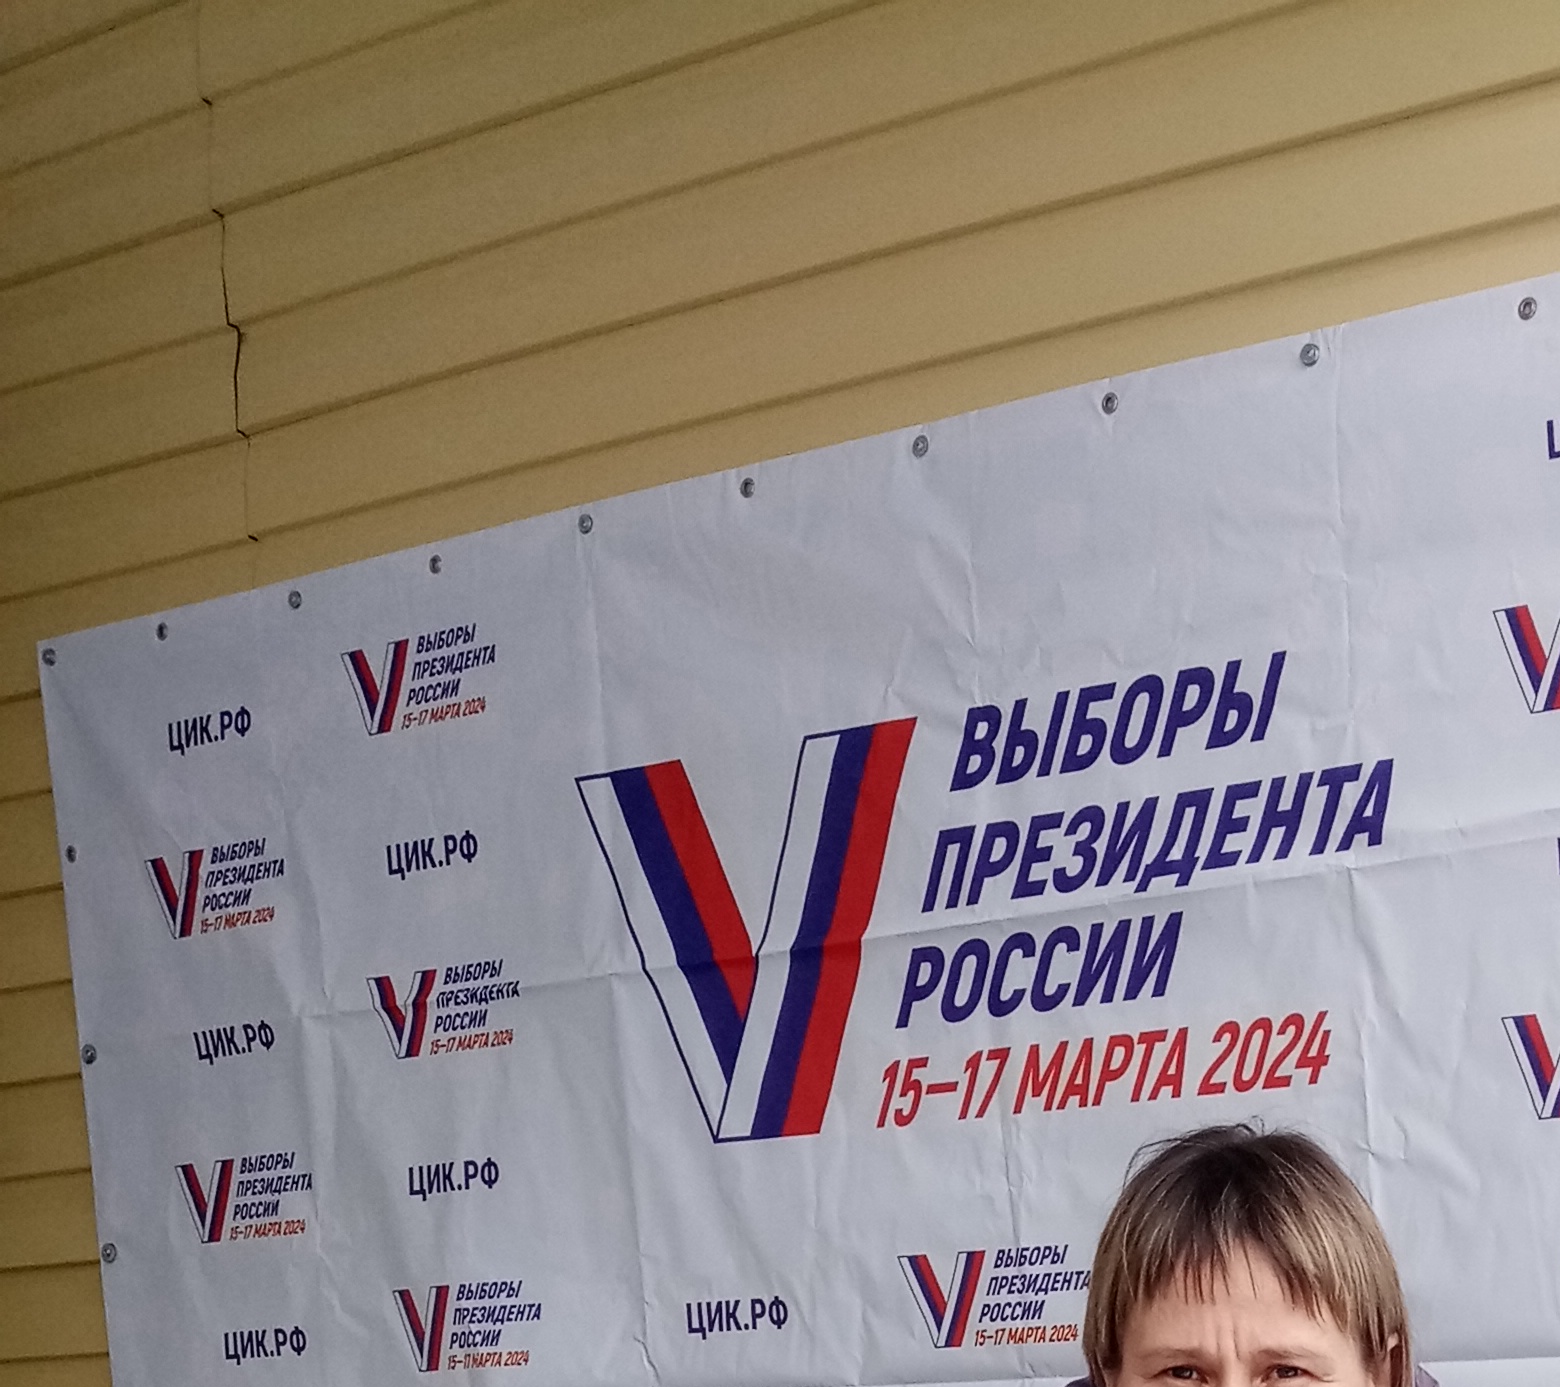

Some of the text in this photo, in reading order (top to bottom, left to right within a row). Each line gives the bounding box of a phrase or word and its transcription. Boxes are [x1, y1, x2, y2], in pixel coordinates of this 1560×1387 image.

[416, 623, 476, 654] ВЫБОРЫ
[412, 644, 495, 681] ПРЕЗИДЕНТА
[406, 678, 461, 707] РОССИИ
[429, 702, 461, 724] МАРТА
[463, 697, 485, 716] 2024
[950, 651, 1286, 792] ВЫБОРЫ
[168, 706, 251, 756] ЦИК.РФ
[921, 758, 1394, 912] ПРЕЗИДЕНТА
[211, 838, 266, 864] ВЫБОРЫ
[387, 830, 477, 880] ЦИК.РФ
[205, 859, 284, 888] ПРЕЗИДЕНТА
[202, 888, 252, 913] РОССИИ
[252, 907, 274, 924] 2024
[443, 959, 503, 985] ВЫБОРЫ
[895, 911, 1183, 1029] РОССИИ
[434, 1009, 487, 1033] РОССИИ
[193, 1020, 274, 1065] ЦИК.РФ
[456, 1032, 489, 1051] МАРТА
[491, 1029, 513, 1047] 2024
[1013, 1027, 1188, 1114] МАРТА
[1197, 1011, 1331, 1096] 2024
[240, 1152, 295, 1174] ВЫБОРЫ
[236, 1173, 312, 1197] ПРЕЗИДЕНТА
[409, 1157, 499, 1201] ЦИК.РФ
[233, 1199, 279, 1221] РОССИИ
[253, 1222, 281, 1238] МАРТА
[283, 1220, 305, 1235] 2024
[994, 1245, 1068, 1269] ВЫБОРЫ
[456, 1280, 522, 1301] ВЫБОРЫ
[986, 1271, 1091, 1296] ПРЕЗИДЕНТА
[453, 1303, 541, 1325] ПРЕЗИДЕНТА
[686, 1296, 788, 1340] ЦИК.РФ
[979, 1300, 1045, 1323] РОССИИ
[224, 1326, 306, 1365] ЦИК.РФ
[449, 1329, 501, 1349] РОССИИ
[1007, 1326, 1046, 1344] МАРТА
[1049, 1324, 1079, 1343] 2024
[504, 1351, 529, 1366] 2024
